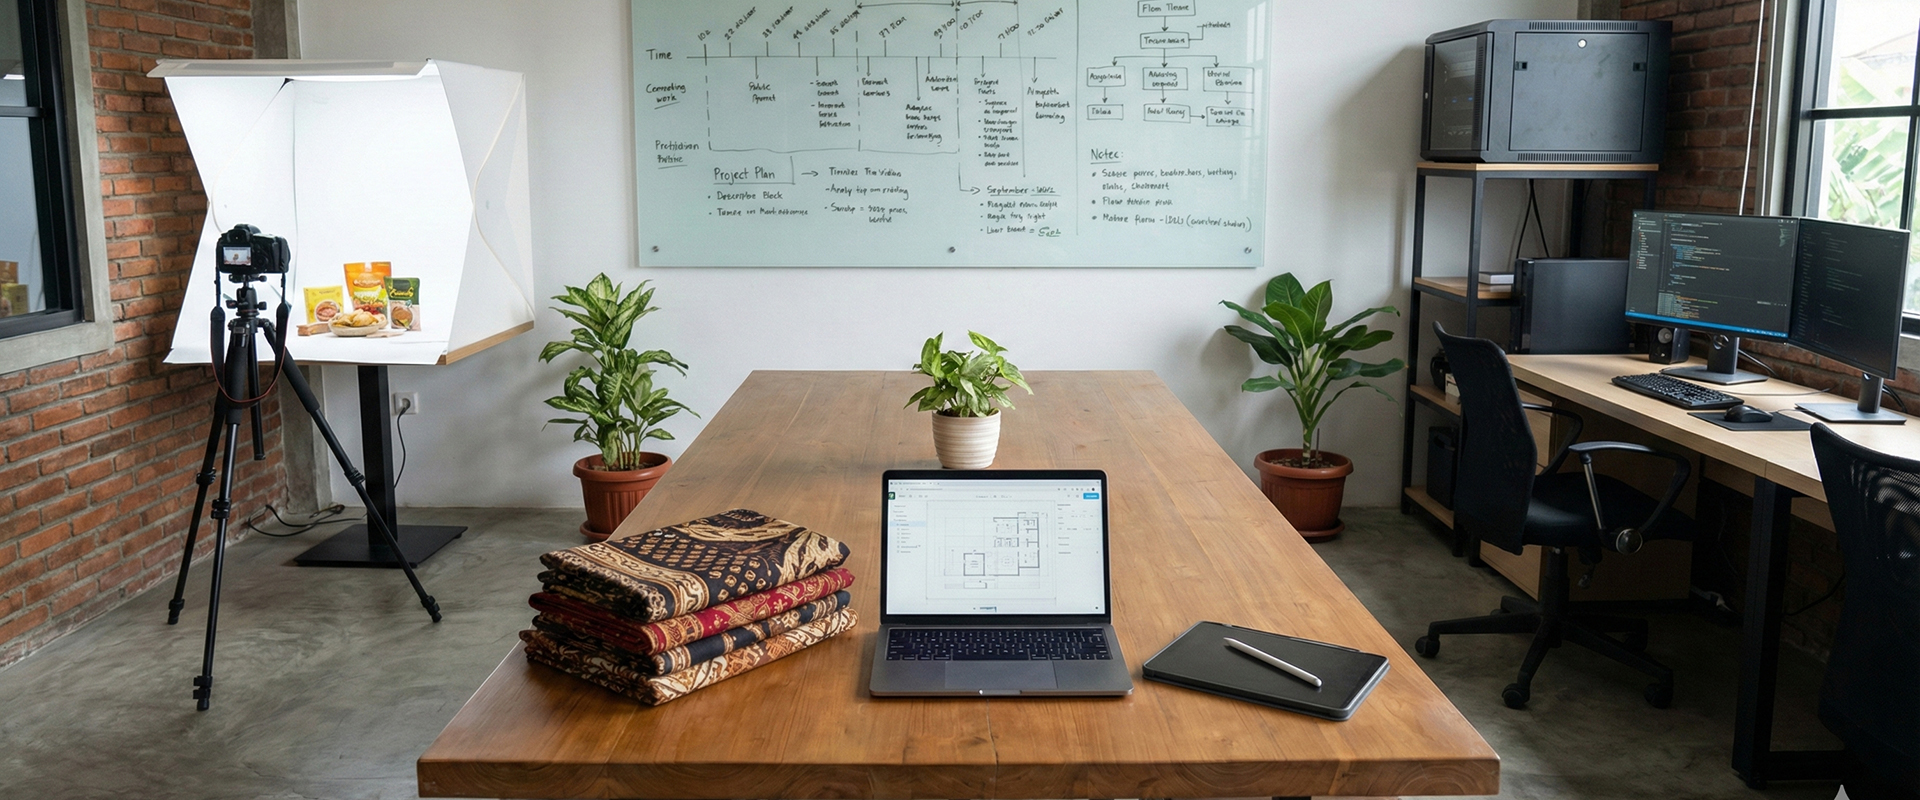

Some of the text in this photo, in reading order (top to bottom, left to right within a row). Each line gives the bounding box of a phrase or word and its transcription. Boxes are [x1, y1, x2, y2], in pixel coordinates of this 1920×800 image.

[646, 48, 673, 60] Time
[713, 166, 776, 185] Project Plan
[987, 185, 1029, 195] September
